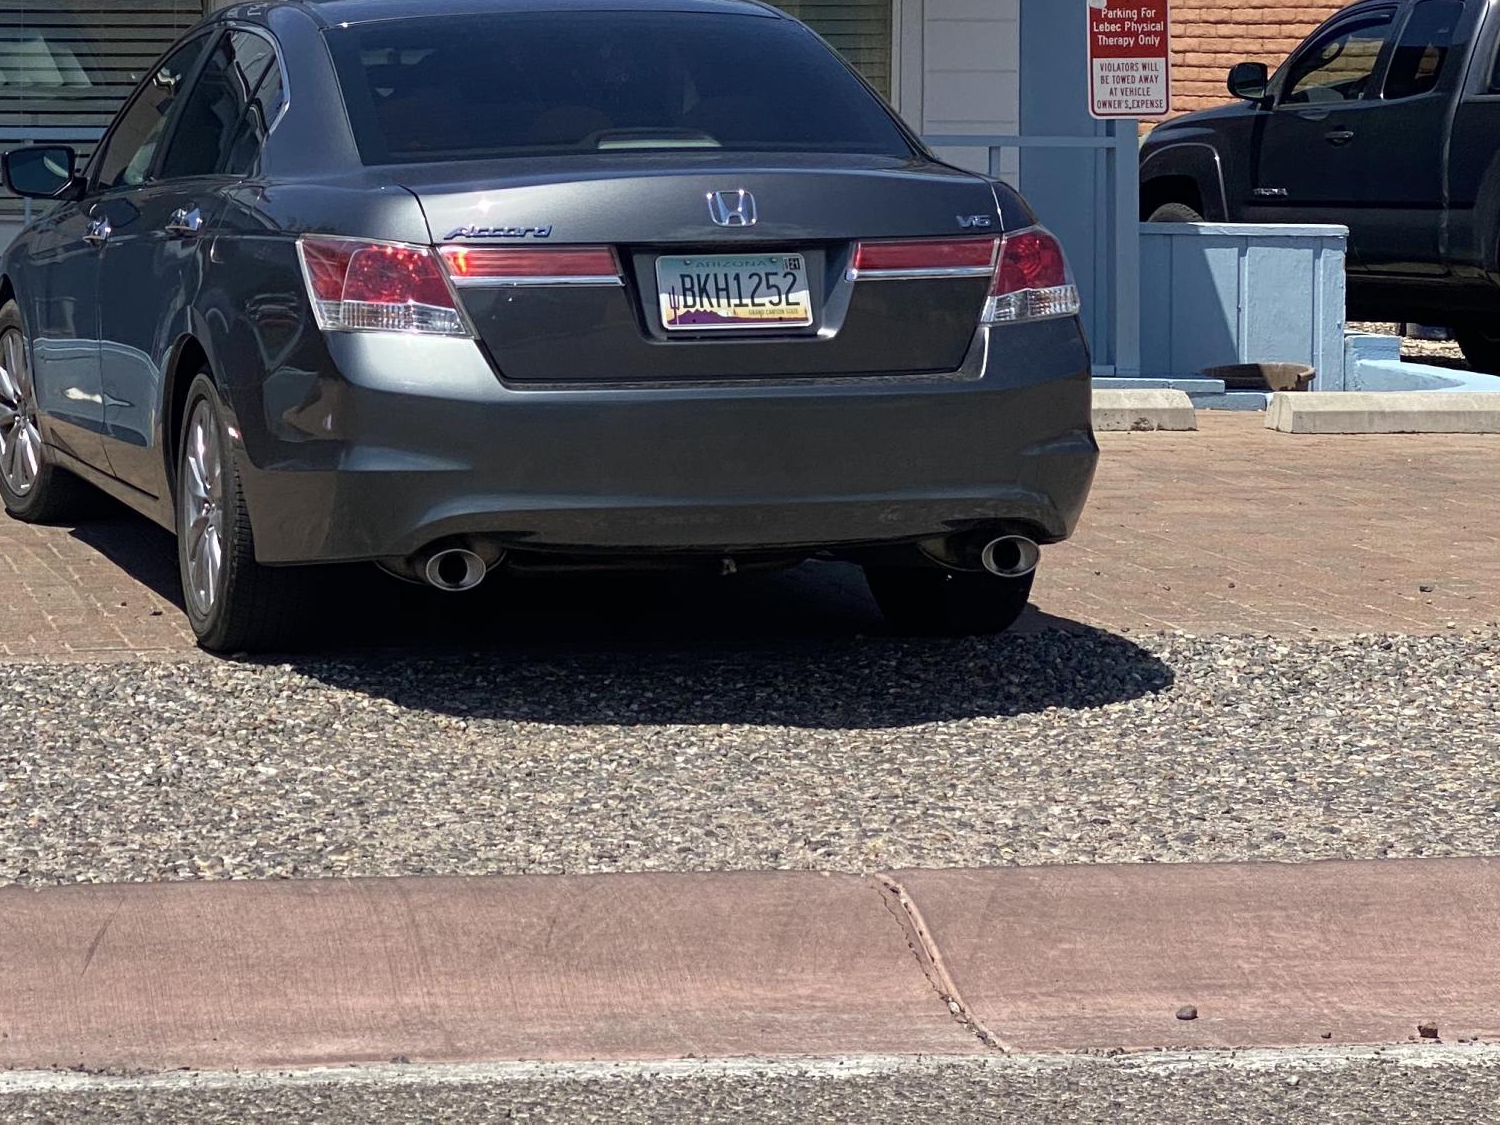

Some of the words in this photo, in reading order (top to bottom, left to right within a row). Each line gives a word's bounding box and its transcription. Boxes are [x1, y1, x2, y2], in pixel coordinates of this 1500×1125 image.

[1101, 8, 1137, 21] Parking
[1141, 7, 1156, 18] For
[1093, 21, 1121, 32] Lebec
[1124, 20, 1164, 34] Physical
[1098, 35, 1135, 48] Therapy
[1138, 34, 1160, 47] Only
[1100, 62, 1139, 72] VIOLATORS
[1141, 62, 1160, 72] WILL
[1100, 75, 1109, 84] BE
[1112, 75, 1136, 84] TOWED
[1138, 74, 1159, 84] AWAY
[1109, 87, 1118, 96] AT
[1120, 87, 1151, 96] VEHICLE
[1131, 99, 1164, 109] EXPENSE
[955, 214, 991, 227] V6
[442, 225, 553, 240] Accord
[695, 259, 767, 269] ARIZONA
[680, 271, 801, 309] BKH1252
